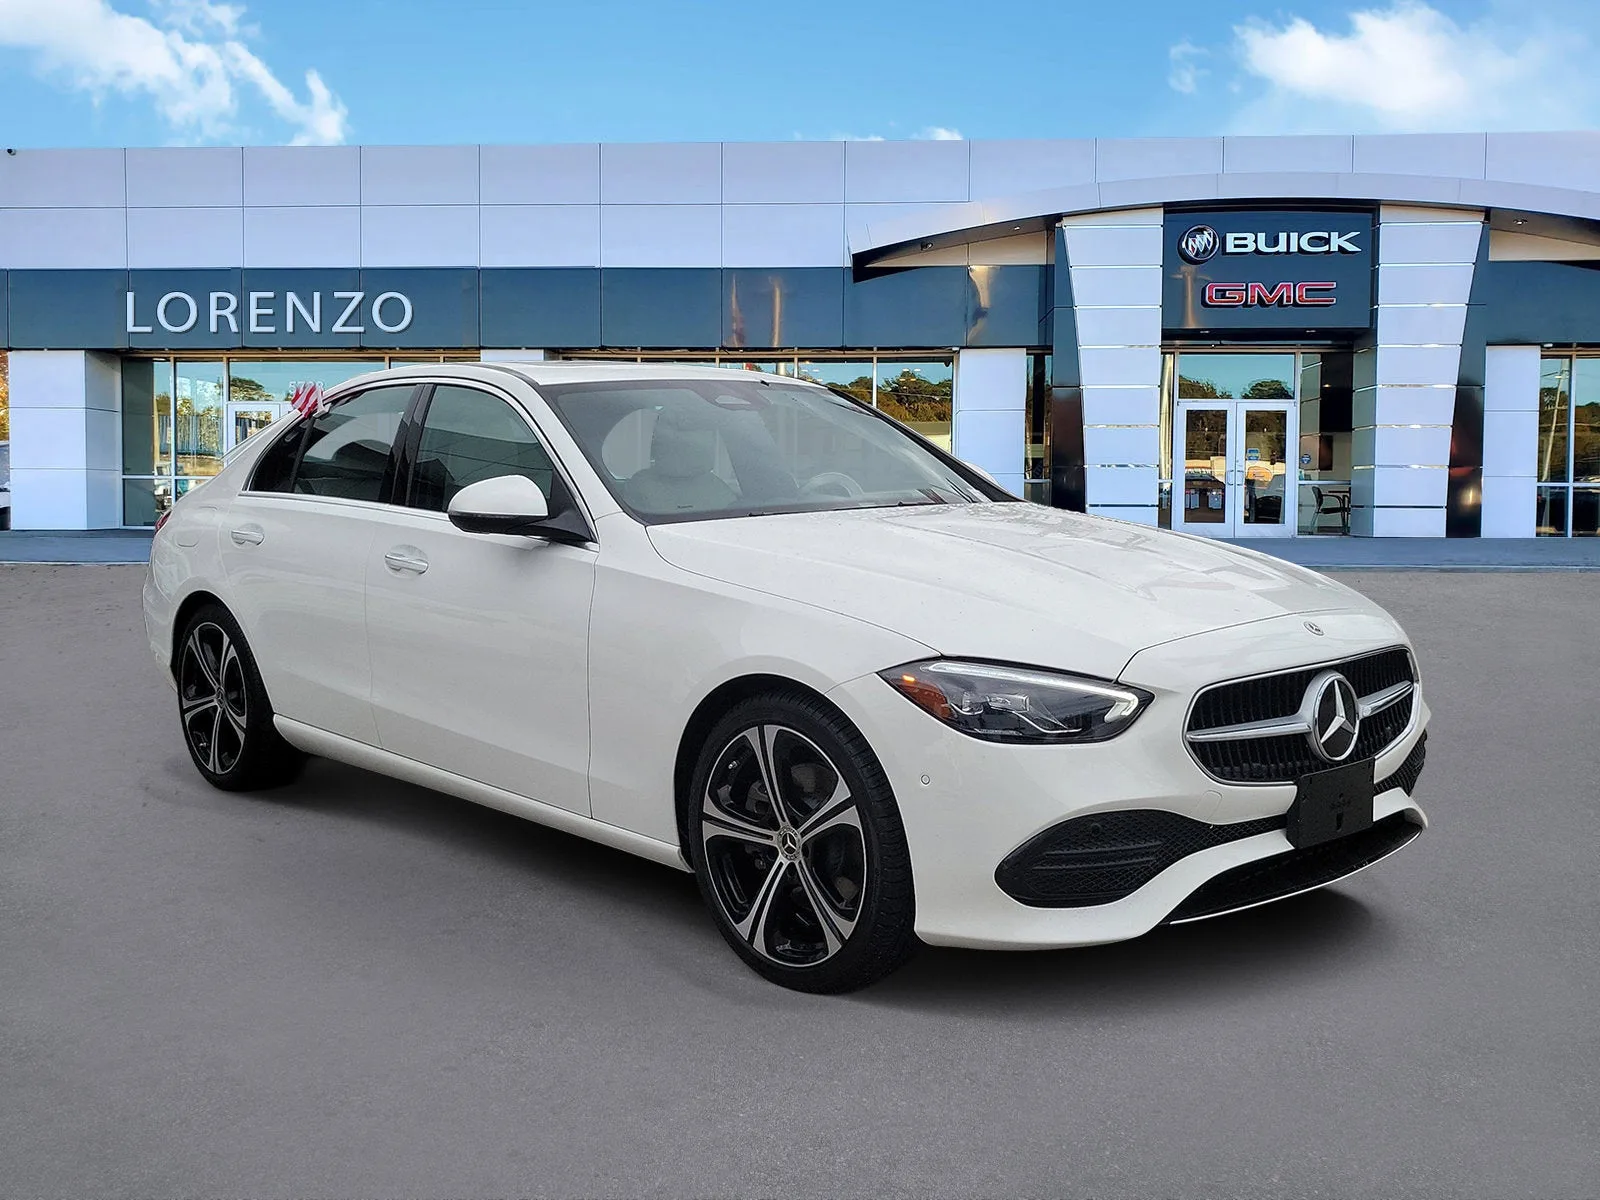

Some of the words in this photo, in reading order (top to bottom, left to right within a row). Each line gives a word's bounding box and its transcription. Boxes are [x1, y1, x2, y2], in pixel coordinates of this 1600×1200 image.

[1225, 231, 1362, 253] BUICK
[1206, 282, 1337, 305] GMC
[126, 291, 413, 333] LORENZO
